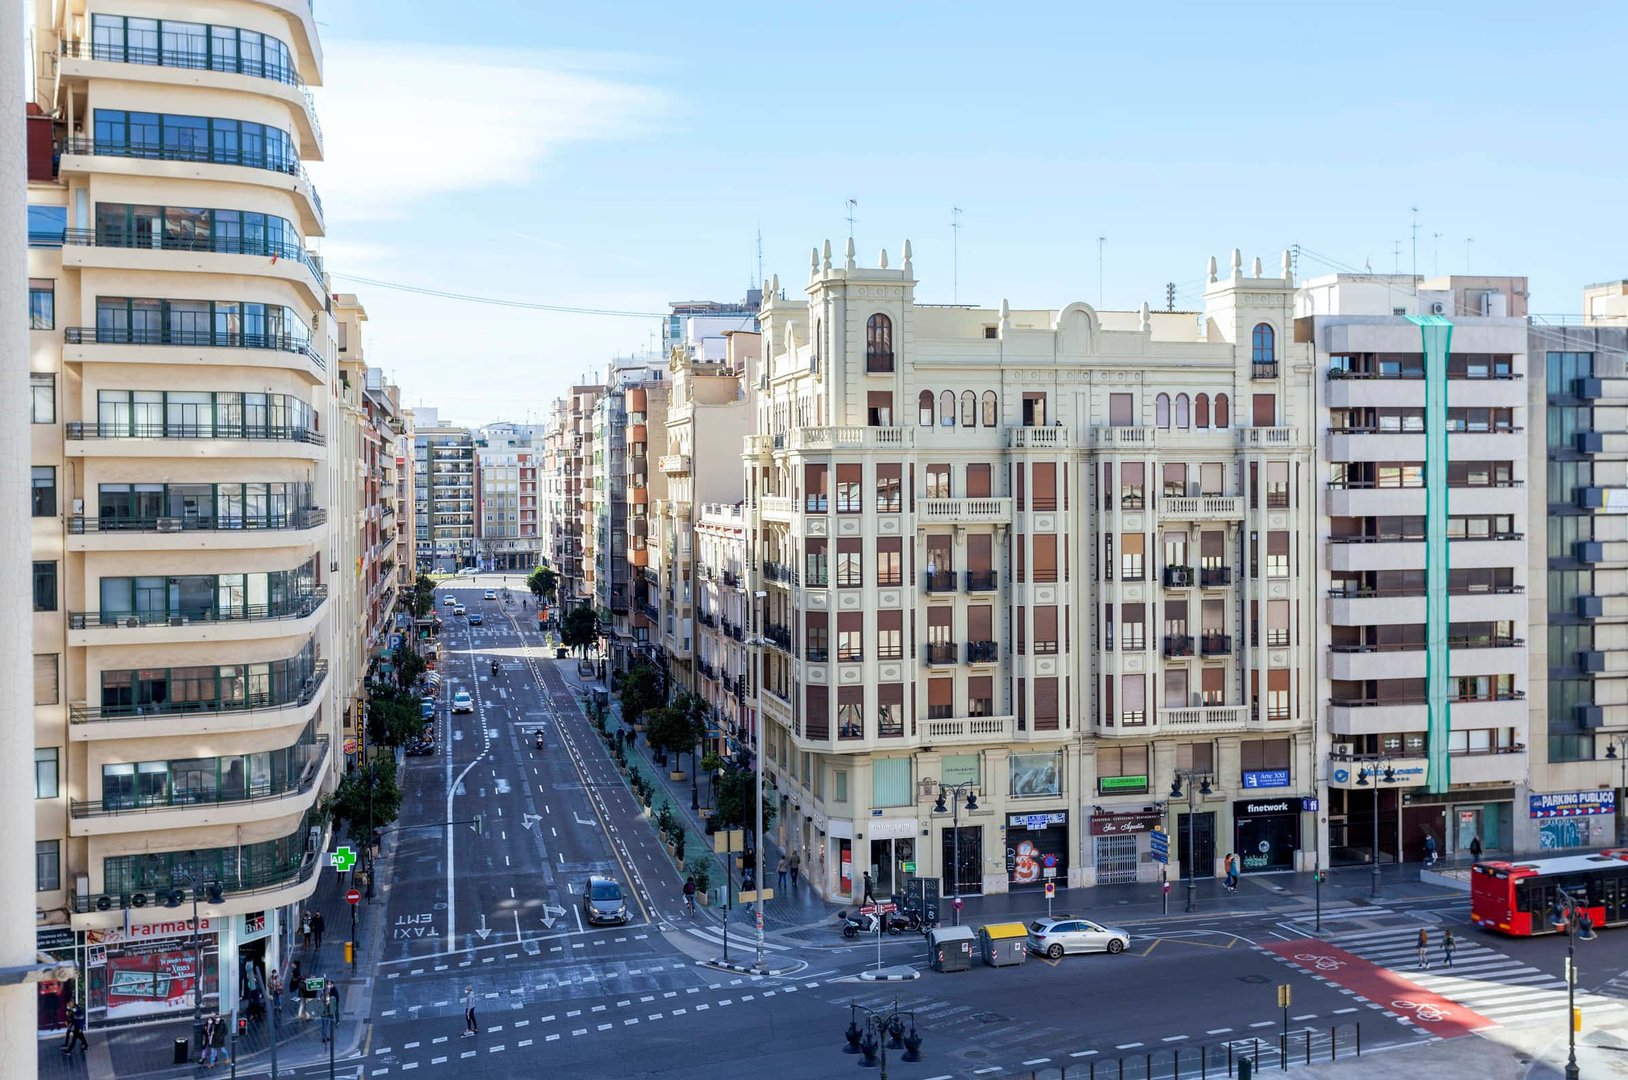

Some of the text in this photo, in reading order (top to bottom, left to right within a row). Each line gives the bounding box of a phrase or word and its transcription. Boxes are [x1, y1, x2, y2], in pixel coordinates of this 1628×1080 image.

[391, 636, 400, 648] P
[1310, 800, 1317, 810] fi
[1541, 792, 1614, 808] PARKING PUBLICO
[1247, 802, 1288, 812] finetwork
[1103, 823, 1116, 832] San
[395, 913, 432, 925] EMT
[393, 926, 439, 939] TAXI
